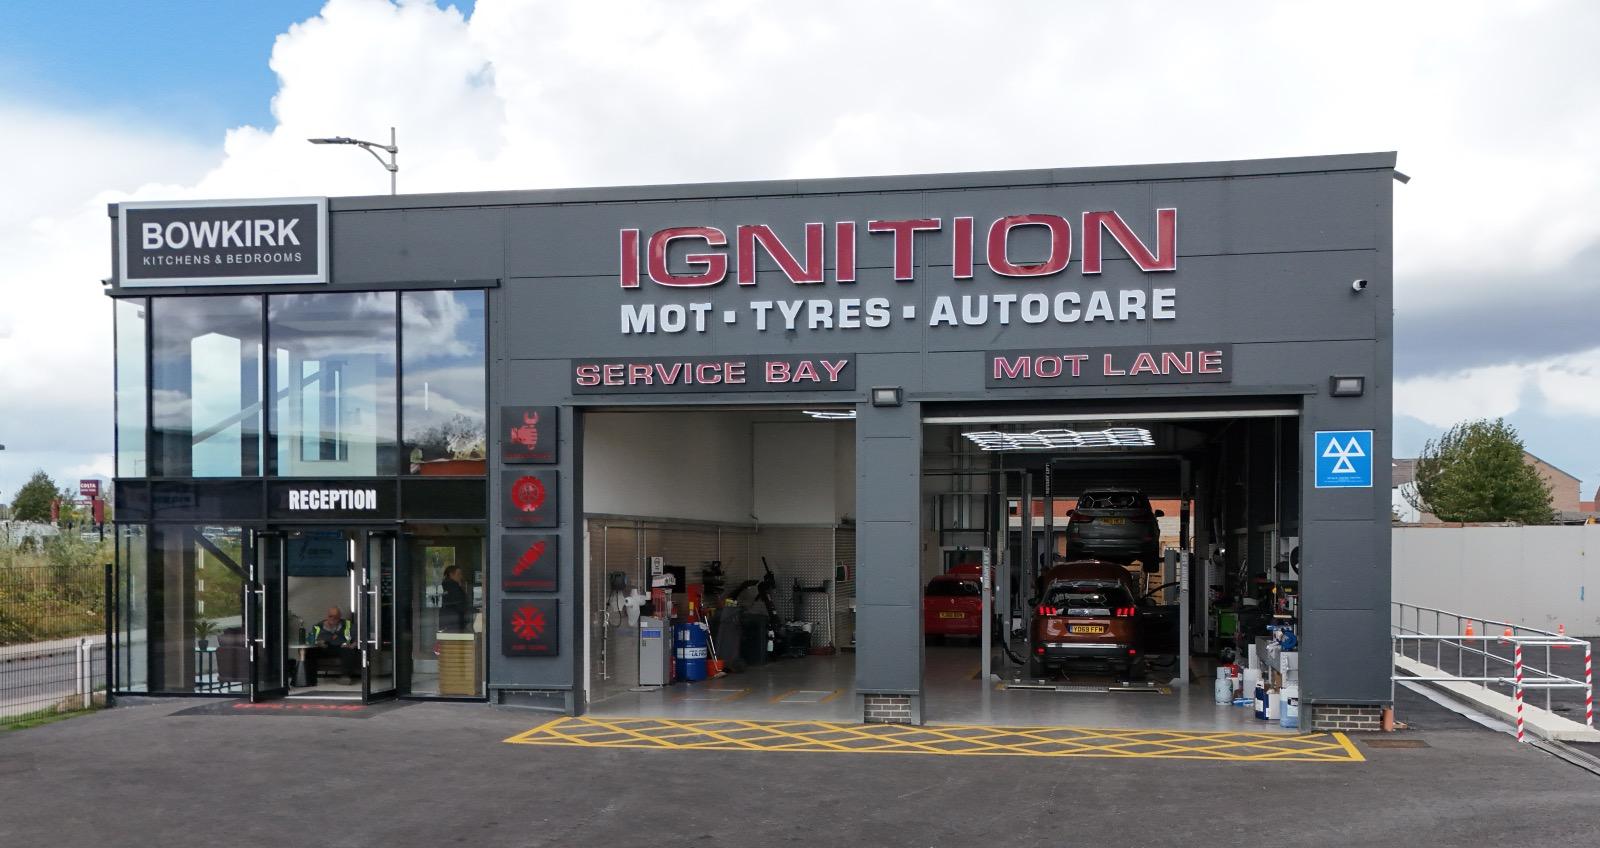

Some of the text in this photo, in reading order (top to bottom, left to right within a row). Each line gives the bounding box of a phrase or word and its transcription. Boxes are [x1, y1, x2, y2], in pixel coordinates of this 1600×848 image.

[142, 218, 300, 250] BOWKIRK
[620, 207, 1177, 288] IGNITION
[143, 252, 302, 266] KITCHENS & BEDROOMS
[621, 288, 1176, 333] MOT TYRES AUTOCARE
[576, 359, 848, 386] SERVICE BAY
[993, 350, 1223, 379] MOT LANE
[289, 489, 377, 510] RECEPTION
